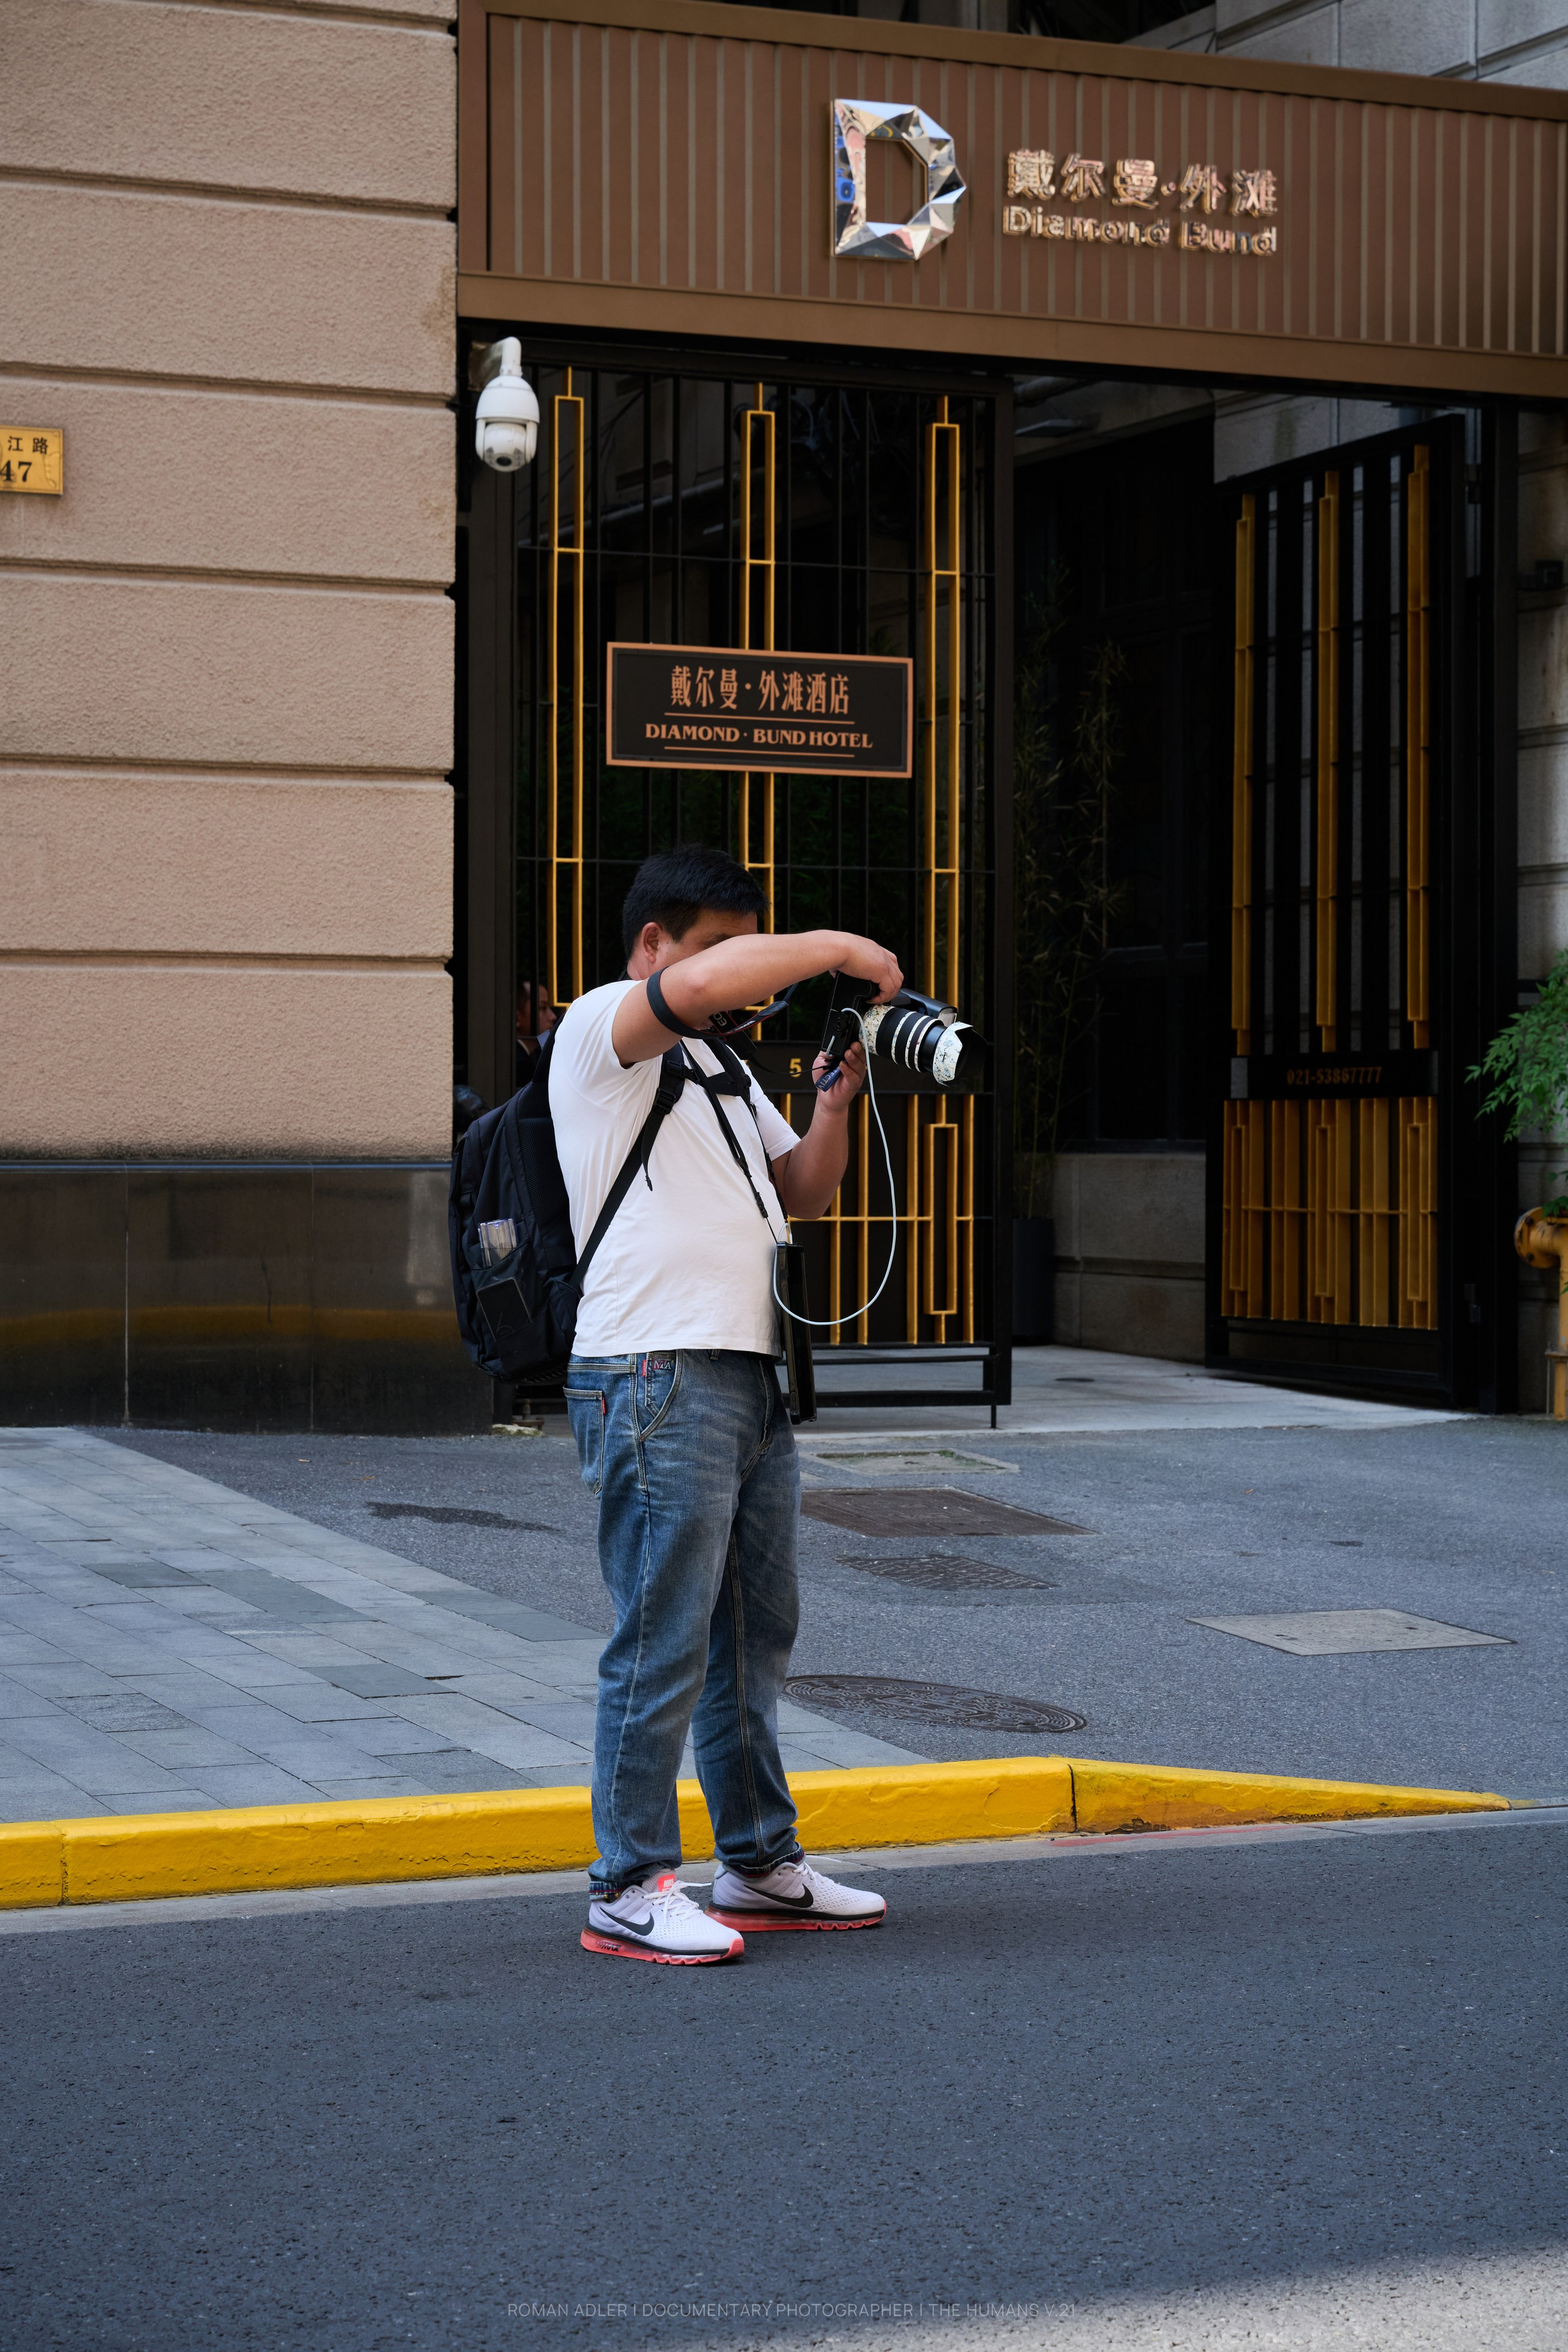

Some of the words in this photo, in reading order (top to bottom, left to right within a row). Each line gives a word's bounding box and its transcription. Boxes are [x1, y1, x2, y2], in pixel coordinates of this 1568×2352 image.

[1003, 205, 1170, 247] Diamond
[1181, 221, 1277, 257] Bund
[670, 665, 850, 715] 戴尔曼·外滩酒店
[645, 723, 740, 742] DIAMOND
[753, 728, 806, 745] BUND
[809, 731, 873, 748] HOTEL
[789, 1058, 802, 1078] 5
[1287, 1066, 1382, 1085] 021-53867777
